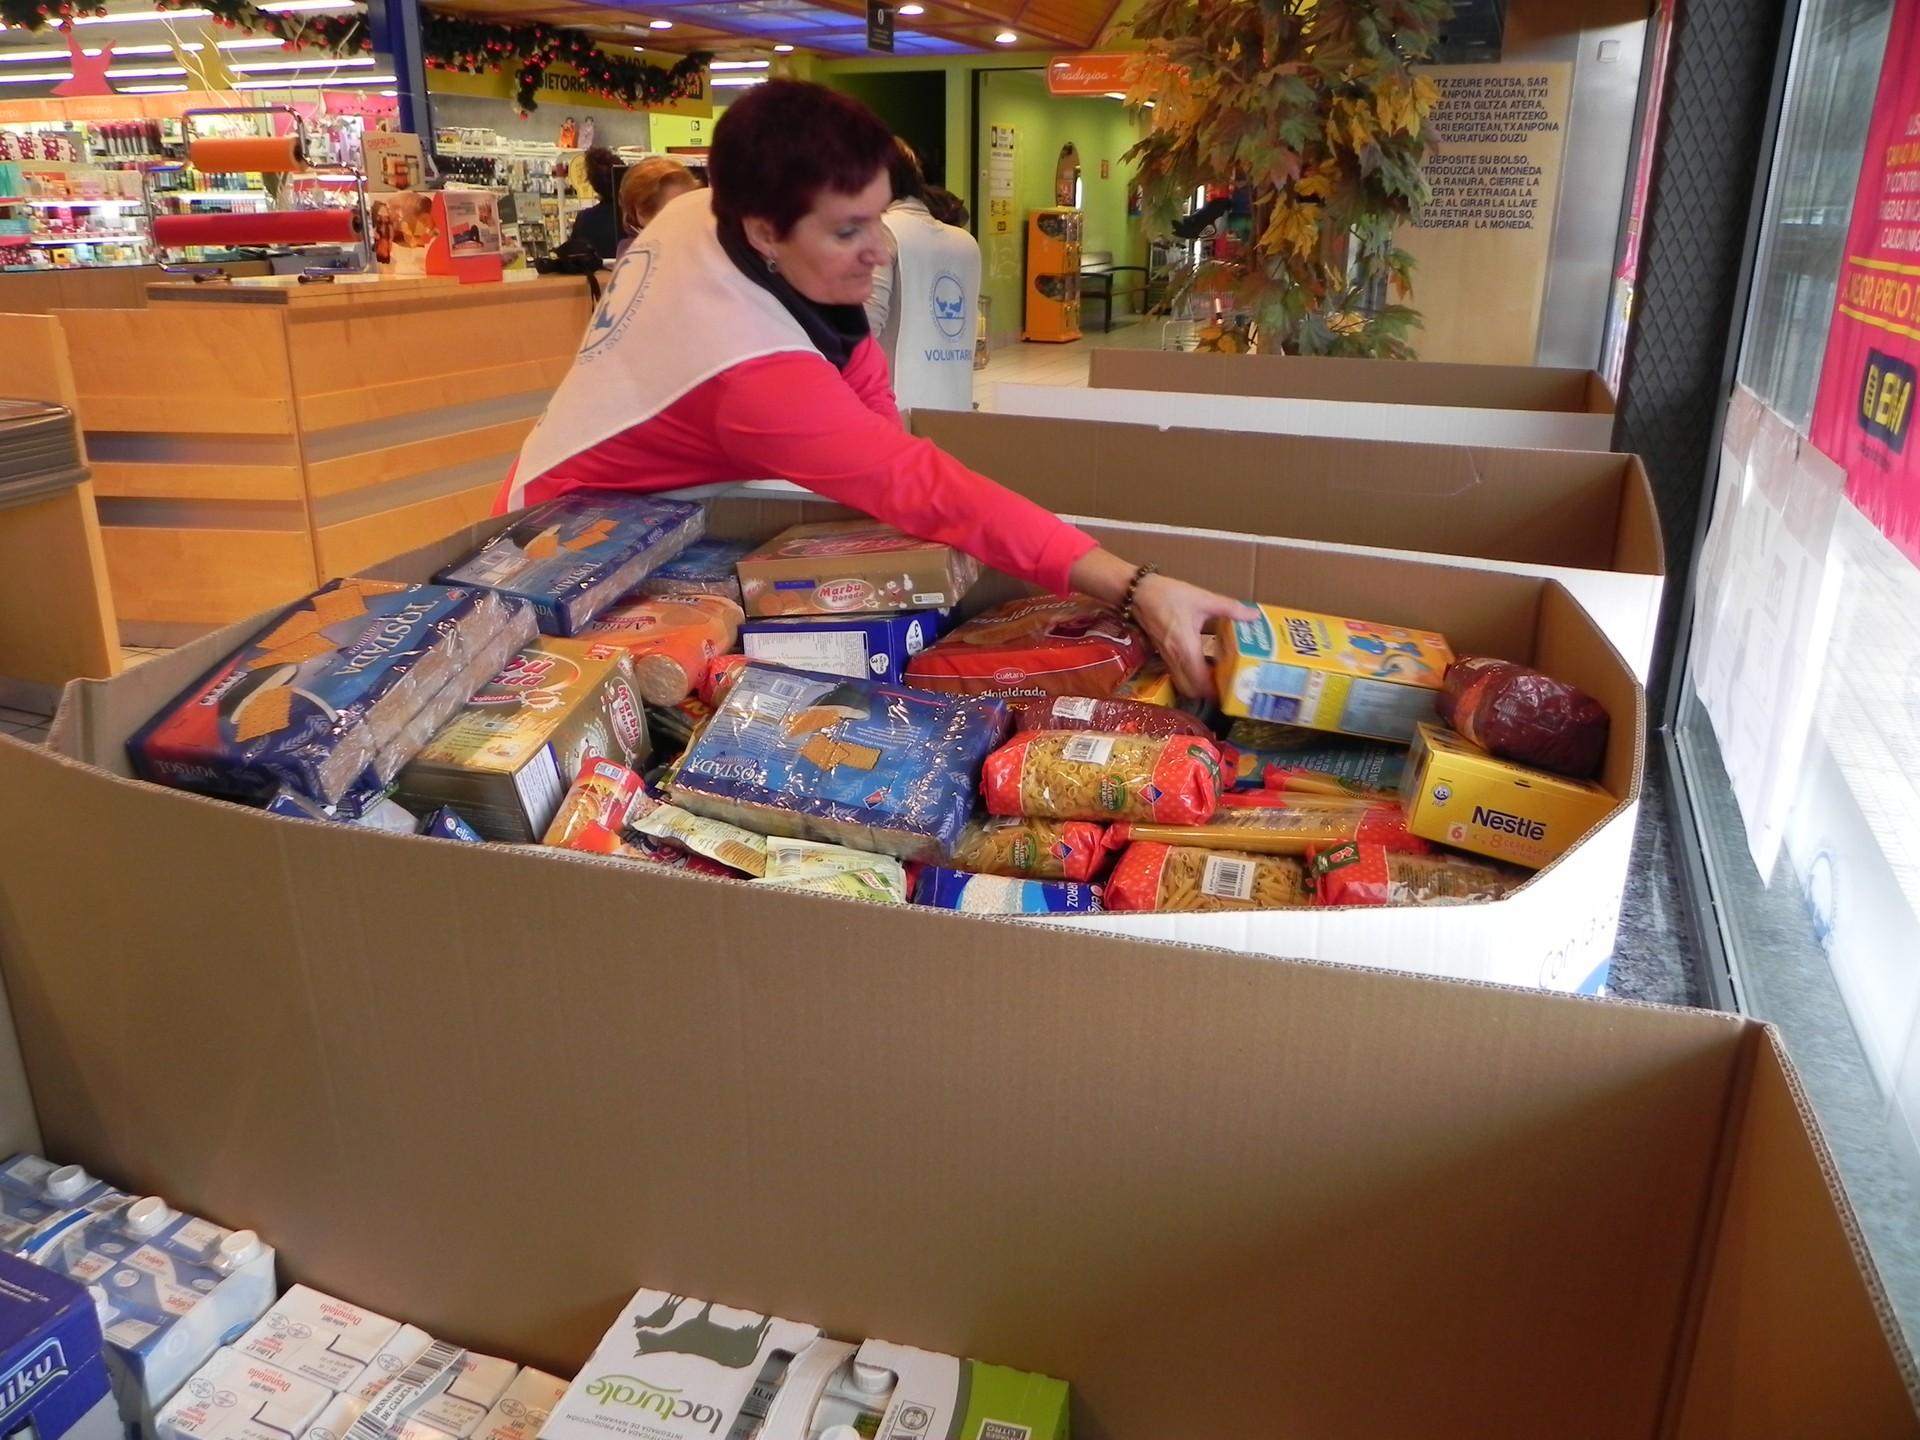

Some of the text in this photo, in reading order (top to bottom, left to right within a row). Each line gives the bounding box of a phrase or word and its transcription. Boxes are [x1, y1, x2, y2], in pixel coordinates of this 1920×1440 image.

[1434, 78, 1547, 88] TZ ZEURE POLTSA, SAR
[1441, 89, 1547, 99] ANPONA ZULOAN, ITXI
[1454, 101, 1471, 110] ETA
[1474, 101, 1507, 110] GILTZA
[1510, 100, 1545, 110] ATERA,
[1428, 112, 1548, 121] EURE POLTSA HARTZEKO
[1434, 123, 1450, 131] ARI
[1440, 134, 1528, 143] SKURATUKO DUZU
[1429, 155, 1530, 166] DEPOSITE SU BOLSO,
[1421, 166, 1542, 176] TRODUZCA UNA MONEDA
[1428, 177, 1539, 187] LA RANURA, CIERRE LA
[1432, 187, 1532, 197] ERTA Y EXTRAIGA LA
[1446, 198, 1458, 208] AL
[1460, 198, 1490, 208] GIRAR
[1492, 198, 1505, 208] LA
[1507, 198, 1538, 208] LLAVE
[1422, 209, 1535, 220] RA RETIRAR SU BOLSO,
[1475, 219, 1487, 229] LA
[1489, 219, 1534, 230] MONEDA.
[924, 350, 973, 361] VOLUNTARI
[548, 561, 603, 595] TOSTADA
[831, 591, 864, 603] Dorada
[971, 600, 1078, 625] ojaldrada
[334, 599, 440, 677] TOSTADA
[995, 671, 1025, 680] Cuétara
[473, 693, 515, 704] ujiente
[1471, 805, 1547, 841] Nestlé
[1451, 826, 1463, 840] 6
[1489, 834, 1503, 849] 8
[1066, 881, 1079, 908] ARROZ
[320, 1303, 362, 1327] Desnatada
[0, 1353, 53, 1411] aiku
[248, 1367, 292, 1393] Desnatada
[371, 1383, 405, 1416] DESNATADA
[380, 1407, 394, 1422] DE
[388, 1386, 413, 1413] GALICIA
[585, 1379, 723, 1434] lacturale
[565, 1413, 616, 1430] PRODUCCIÓN
[594, 1413, 629, 1427] NAVARRA
[616, 1425, 627, 1434] EN
[630, 1422, 641, 1430] DE
